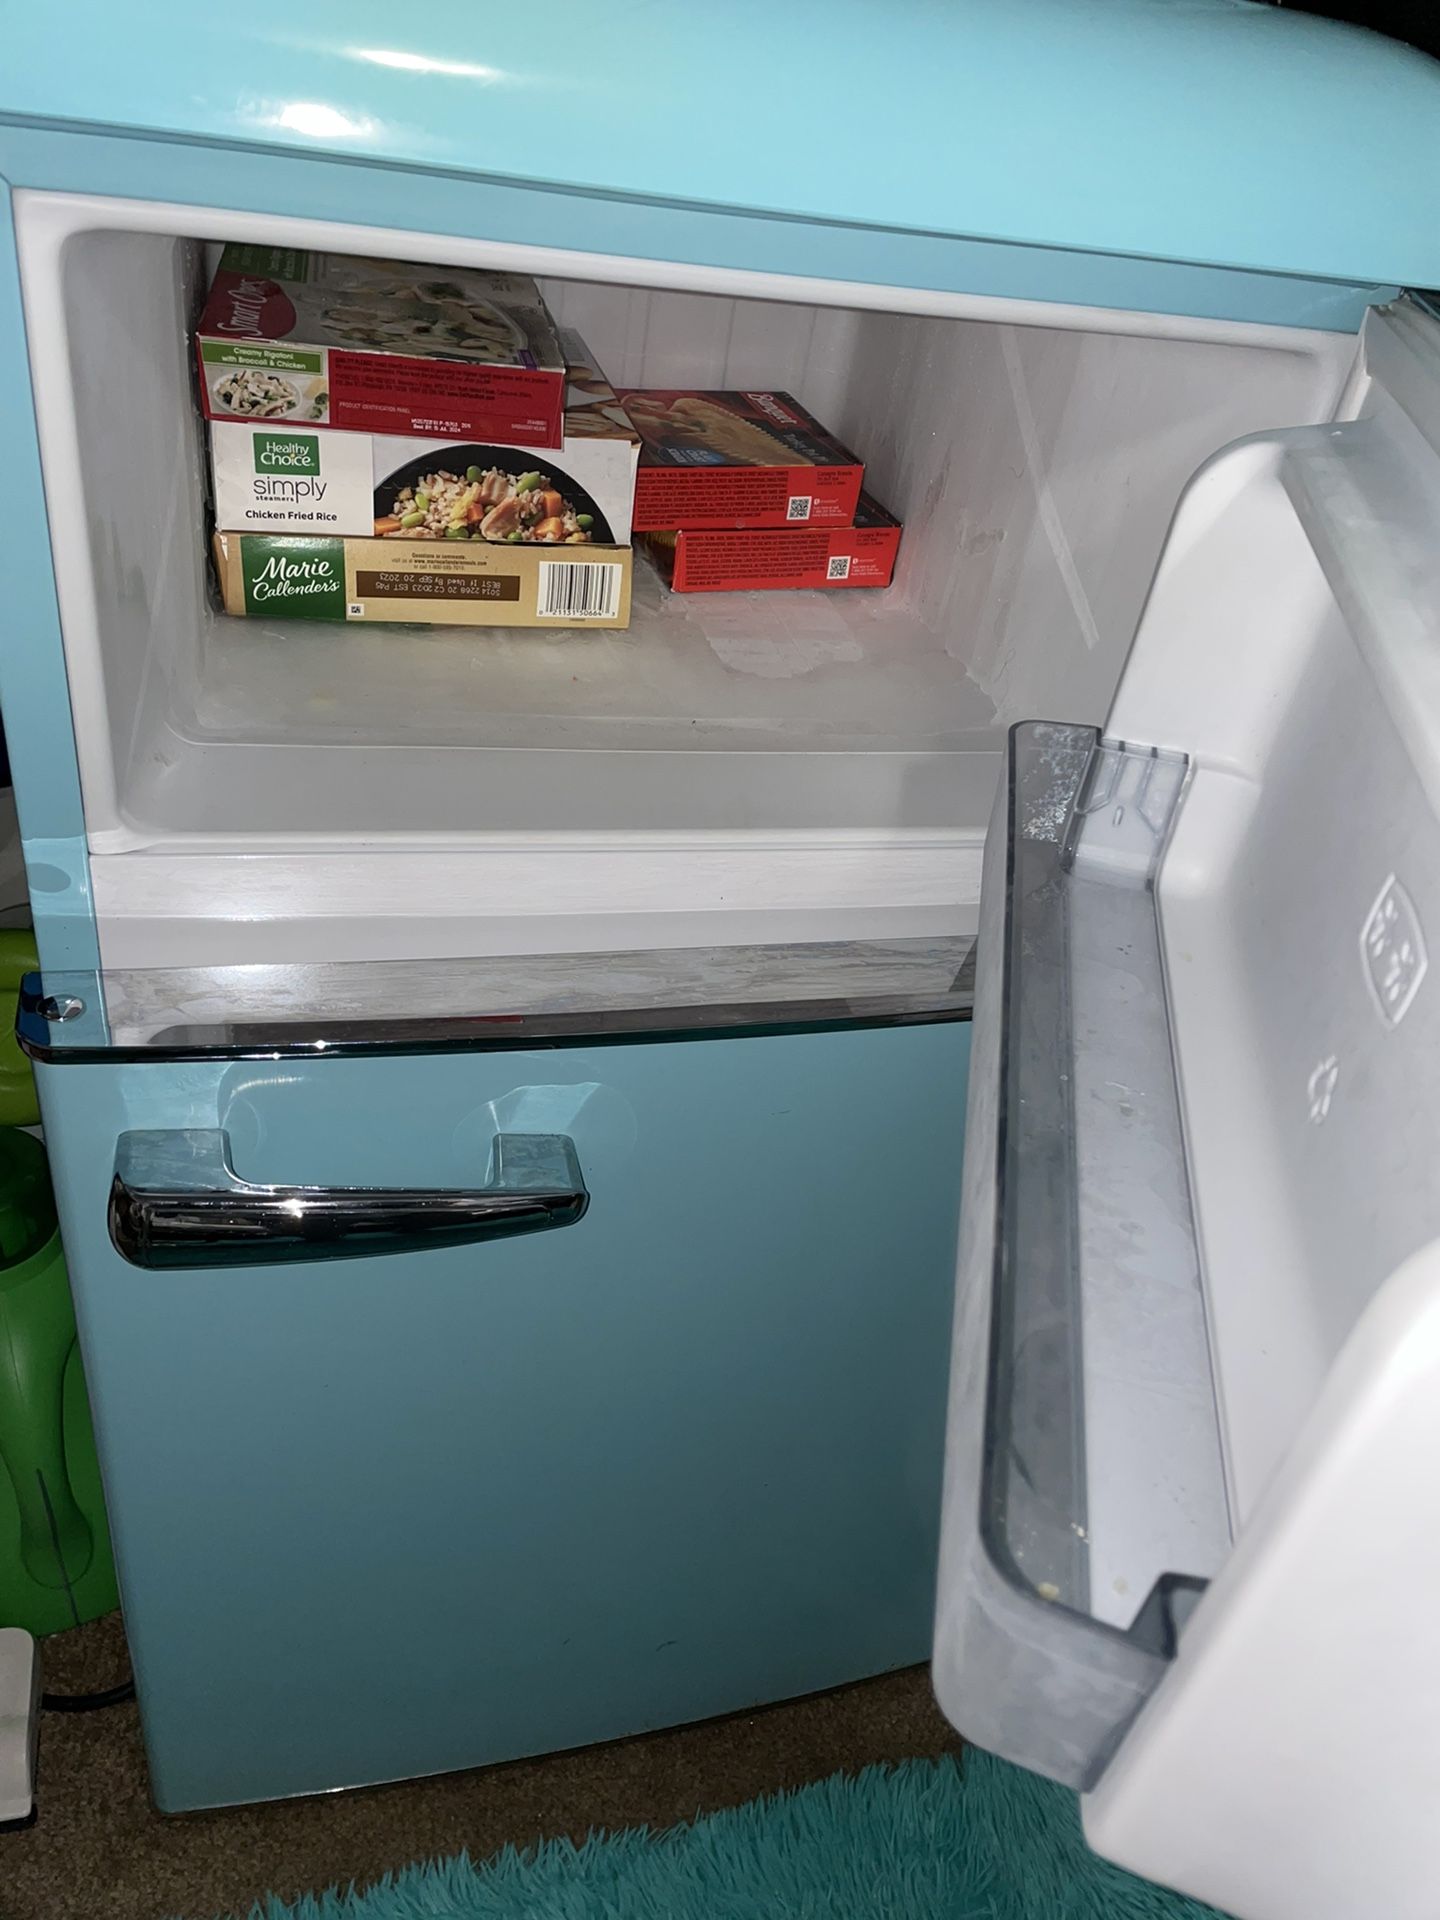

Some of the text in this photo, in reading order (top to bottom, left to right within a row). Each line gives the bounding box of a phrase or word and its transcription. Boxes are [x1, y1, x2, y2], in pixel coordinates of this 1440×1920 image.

[217, 301, 263, 336] Smart
[233, 347, 294, 360] Creamy Rigatoni
[239, 356, 268, 366] Broccoli
[276, 360, 306, 369] Chicken
[266, 441, 310, 456] Healthy
[260, 452, 312, 467] Choice
[253, 476, 327, 503] simply
[245, 510, 338, 521] Chicken Fried Rice
[252, 556, 334, 583] Marie
[379, 572, 400, 582] 2023
[404, 574, 415, 583] 20
[419, 575, 433, 584] SEP
[434, 577, 444, 585] By
[447, 578, 466, 586] Used
[253, 579, 340, 601] Callender's
[393, 582, 409, 591] EST
[434, 585, 445, 593] C2
[447, 586, 458, 594] 20
[480, 581, 501, 589] BEST
[460, 586, 480, 595] 2268
